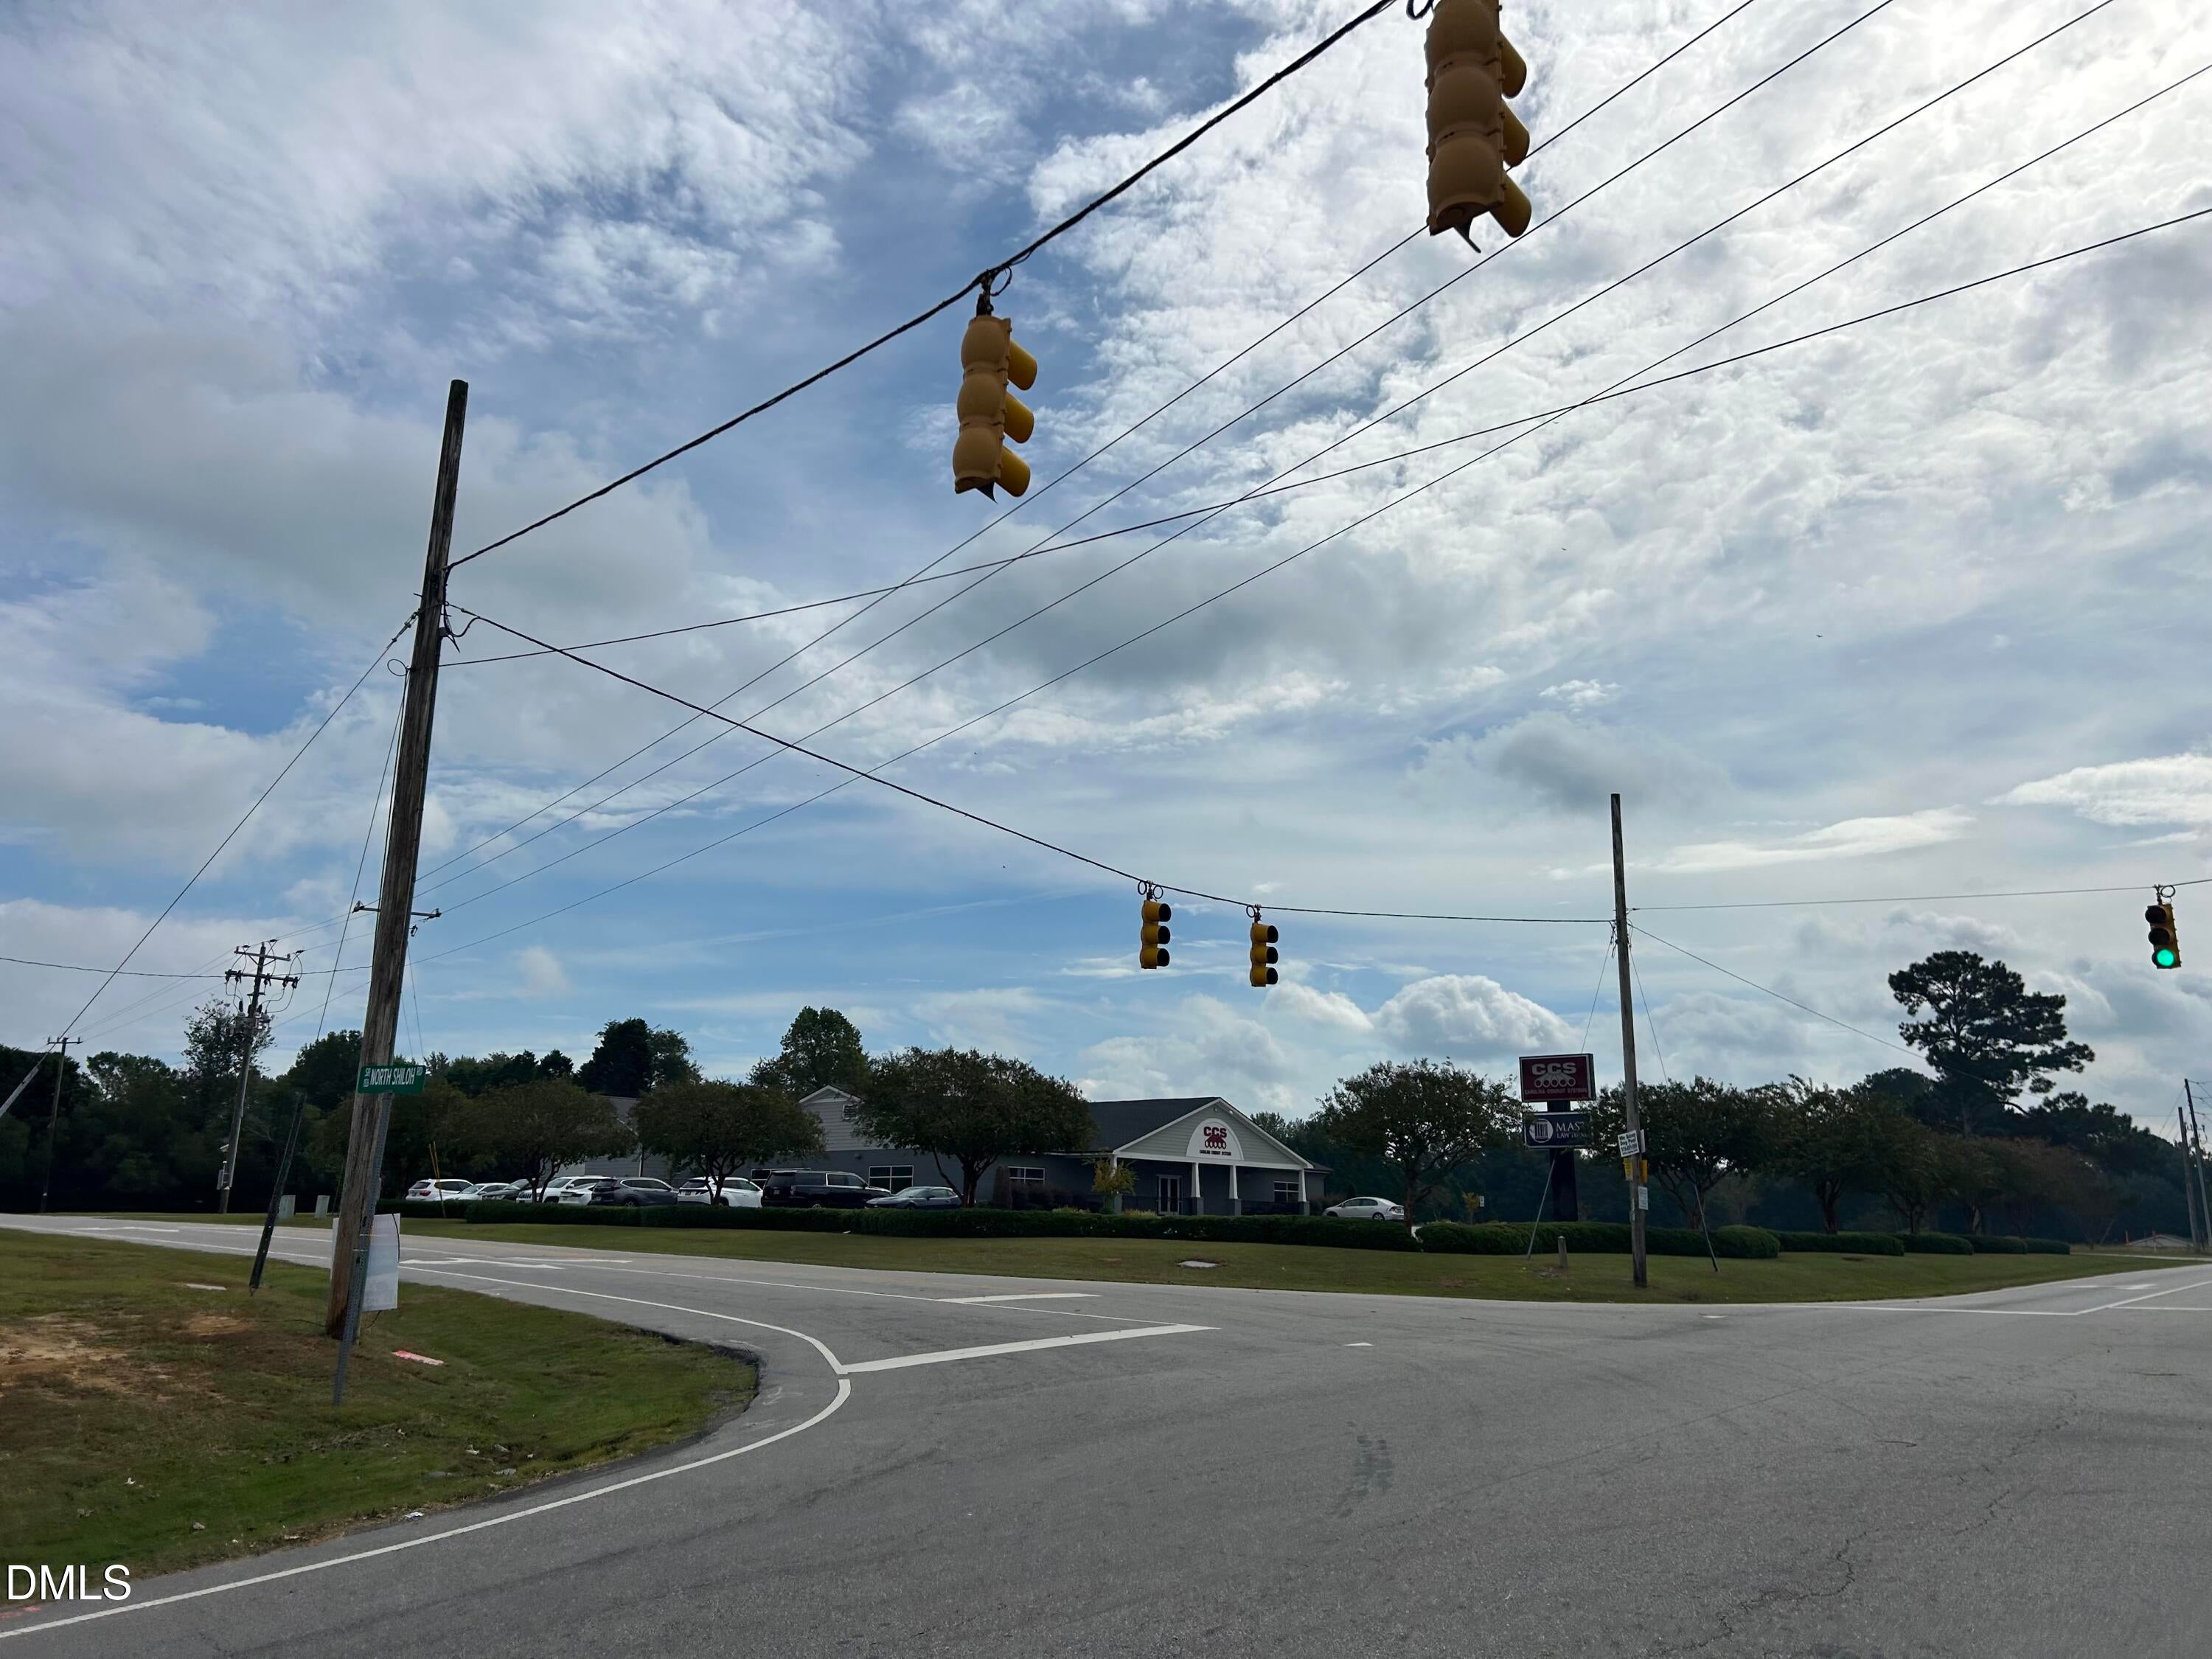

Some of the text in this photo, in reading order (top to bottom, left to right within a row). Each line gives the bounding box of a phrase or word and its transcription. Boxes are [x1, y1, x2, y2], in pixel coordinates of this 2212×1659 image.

[1531, 1062, 1576, 1075] CCS
[369, 1068, 392, 1085] NORTH
[392, 1068, 416, 1085] SHILOH
[416, 1066, 423, 1076] RD
[1203, 1126, 1227, 1138] CCS
